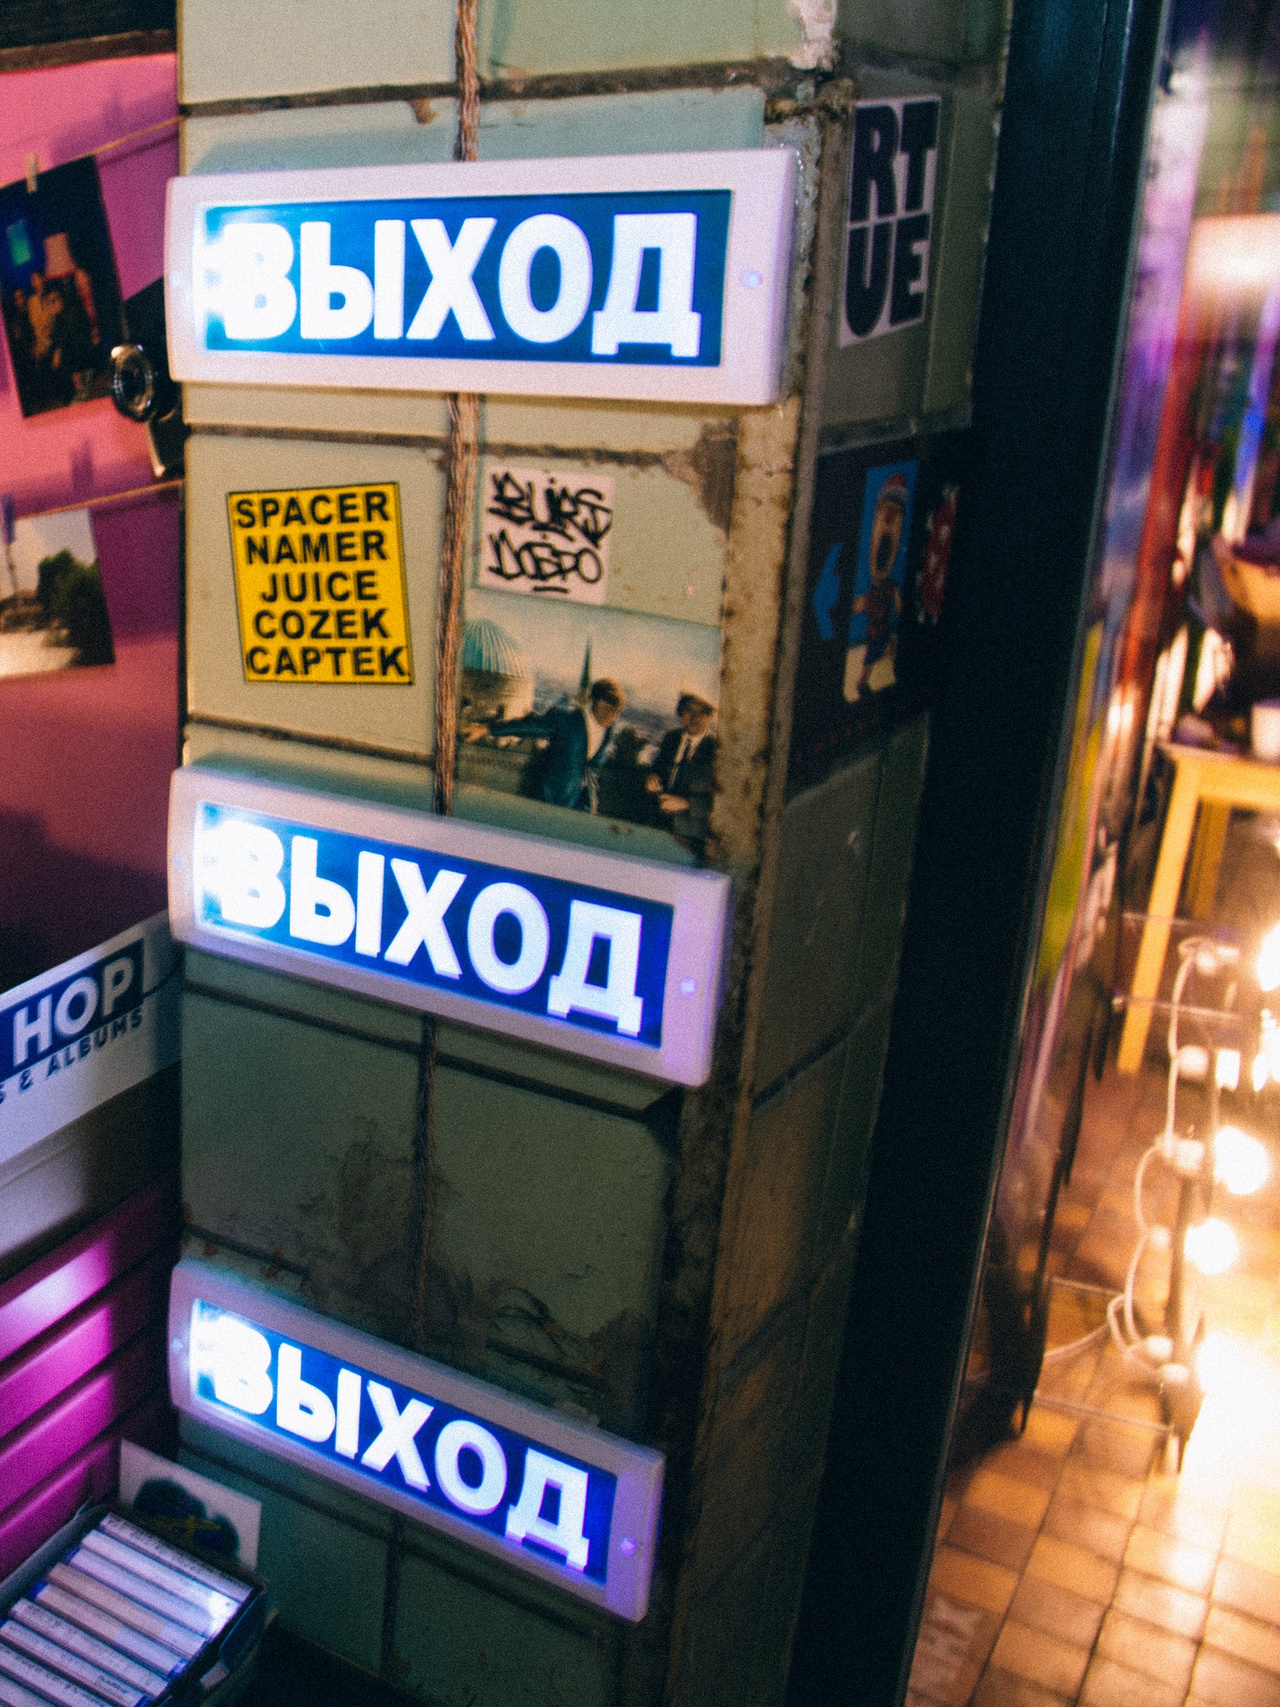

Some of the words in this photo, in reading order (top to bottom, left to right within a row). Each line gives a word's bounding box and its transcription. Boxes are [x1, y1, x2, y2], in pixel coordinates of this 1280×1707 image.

[849, 101, 940, 224] RT
[219, 213, 702, 357] ВЫХОД
[845, 213, 931, 337] UE
[236, 491, 390, 528] SPACER
[246, 530, 387, 564] NAMER
[253, 608, 389, 639] COZEK
[261, 570, 379, 602] JUICE
[246, 646, 406, 676] CAPTEK
[218, 818, 644, 1037] ВЫХОД
[13, 956, 135, 1067] HOP
[19, 1070, 34, 1091] &
[45, 1006, 144, 1078] ALBUMS
[212, 1313, 590, 1573] ВЫХОД
